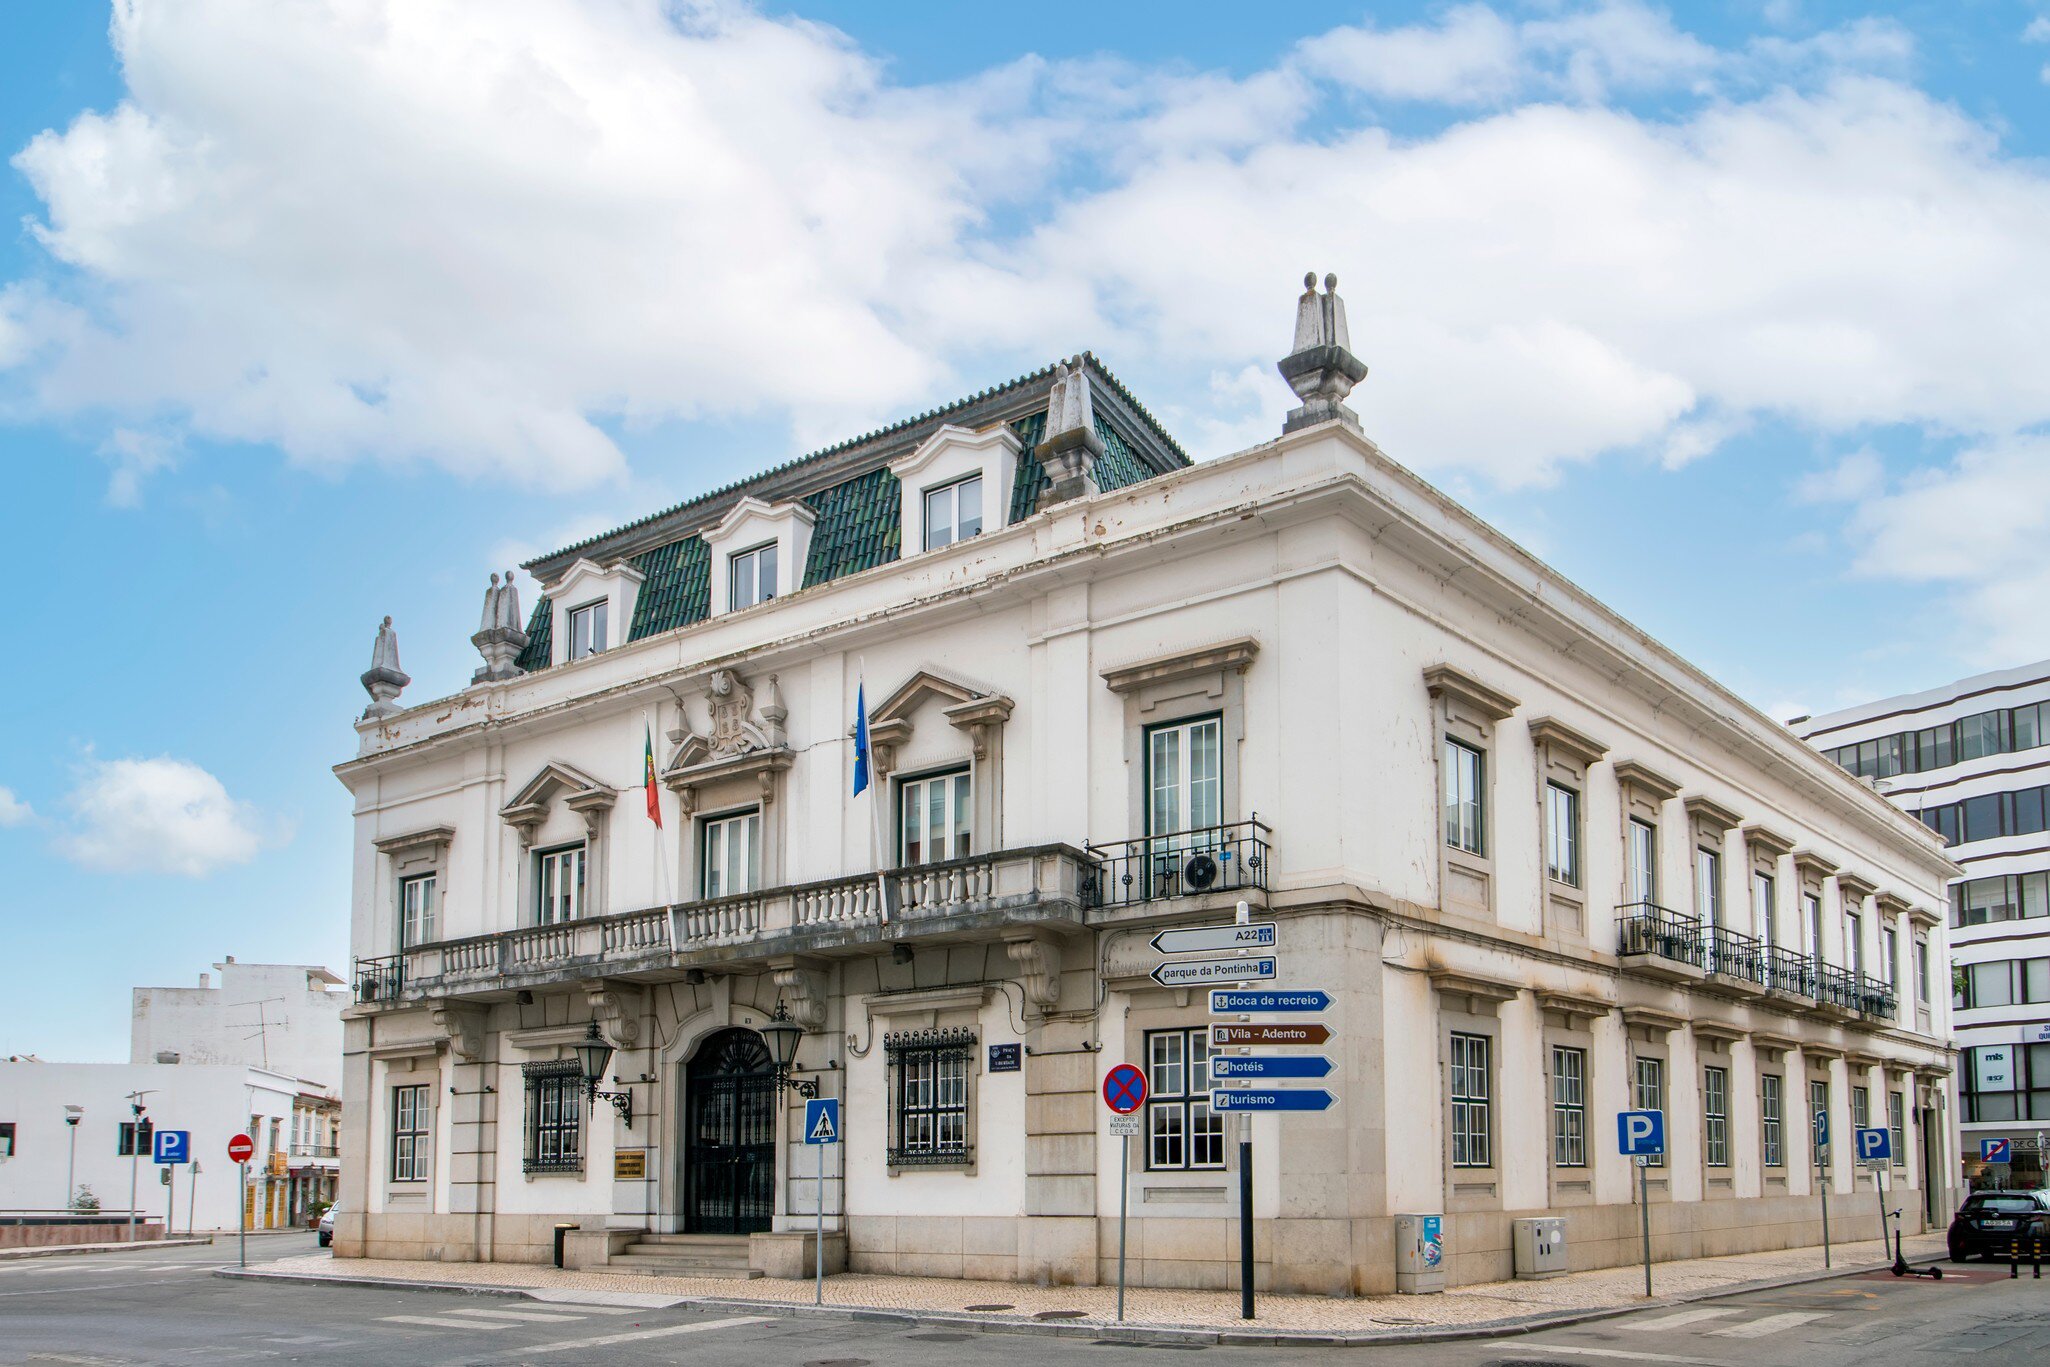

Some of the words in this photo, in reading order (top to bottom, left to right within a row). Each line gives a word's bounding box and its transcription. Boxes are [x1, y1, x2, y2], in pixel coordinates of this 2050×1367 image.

[1235, 930, 1258, 941] A22
[1164, 967, 1197, 980] parque
[1200, 966, 1212, 976] da
[1214, 963, 1259, 975] Pontinha
[1229, 996, 1258, 1006] doca
[1260, 996, 1275, 1006] de
[1278, 995, 1319, 1005] recreio
[1229, 1028, 1251, 1039] Vila
[1262, 1028, 1307, 1039] Adentro
[1229, 1061, 1264, 1072] hotéis
[1229, 1094, 1276, 1104] turismo
[1626, 1115, 1654, 1151] P
[1818, 1115, 1826, 1143] P
[160, 1132, 180, 1157] P
[1863, 1131, 1883, 1157] P
[1986, 1140, 2004, 1161] P
